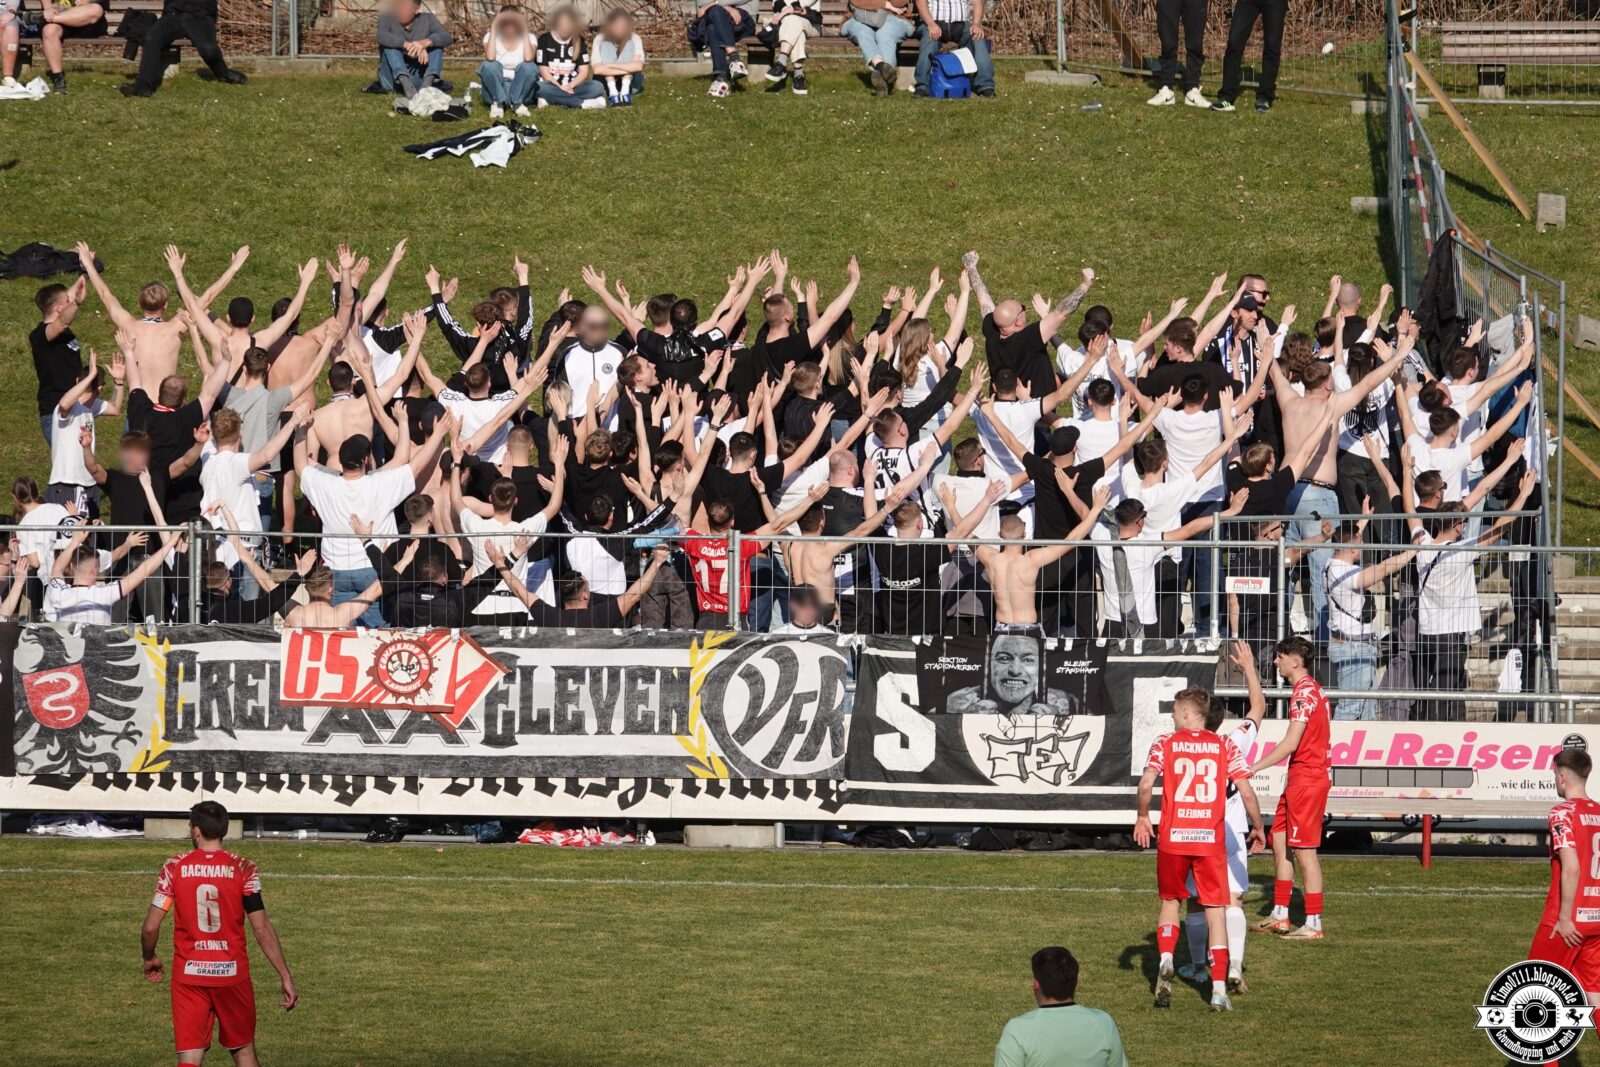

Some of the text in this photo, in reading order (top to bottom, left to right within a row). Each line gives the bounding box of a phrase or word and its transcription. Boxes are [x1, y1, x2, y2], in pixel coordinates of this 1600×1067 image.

[695, 559, 729, 594] 17
[938, 656, 968, 664] SEKTION
[1063, 660, 1092, 668] BLEIBT
[924, 663, 981, 671] STADIONVERBOT
[1055, 667, 1099, 675] STANDHAFT
[480, 651, 693, 749] ELEVEN
[1172, 741, 1220, 754] BACKNANG
[1173, 757, 1218, 803] 23
[1520, 780, 1536, 789] die
[181, 864, 235, 879] BACKNANG
[196, 883, 221, 934] 6
[192, 961, 235, 969] INTERSPORT
